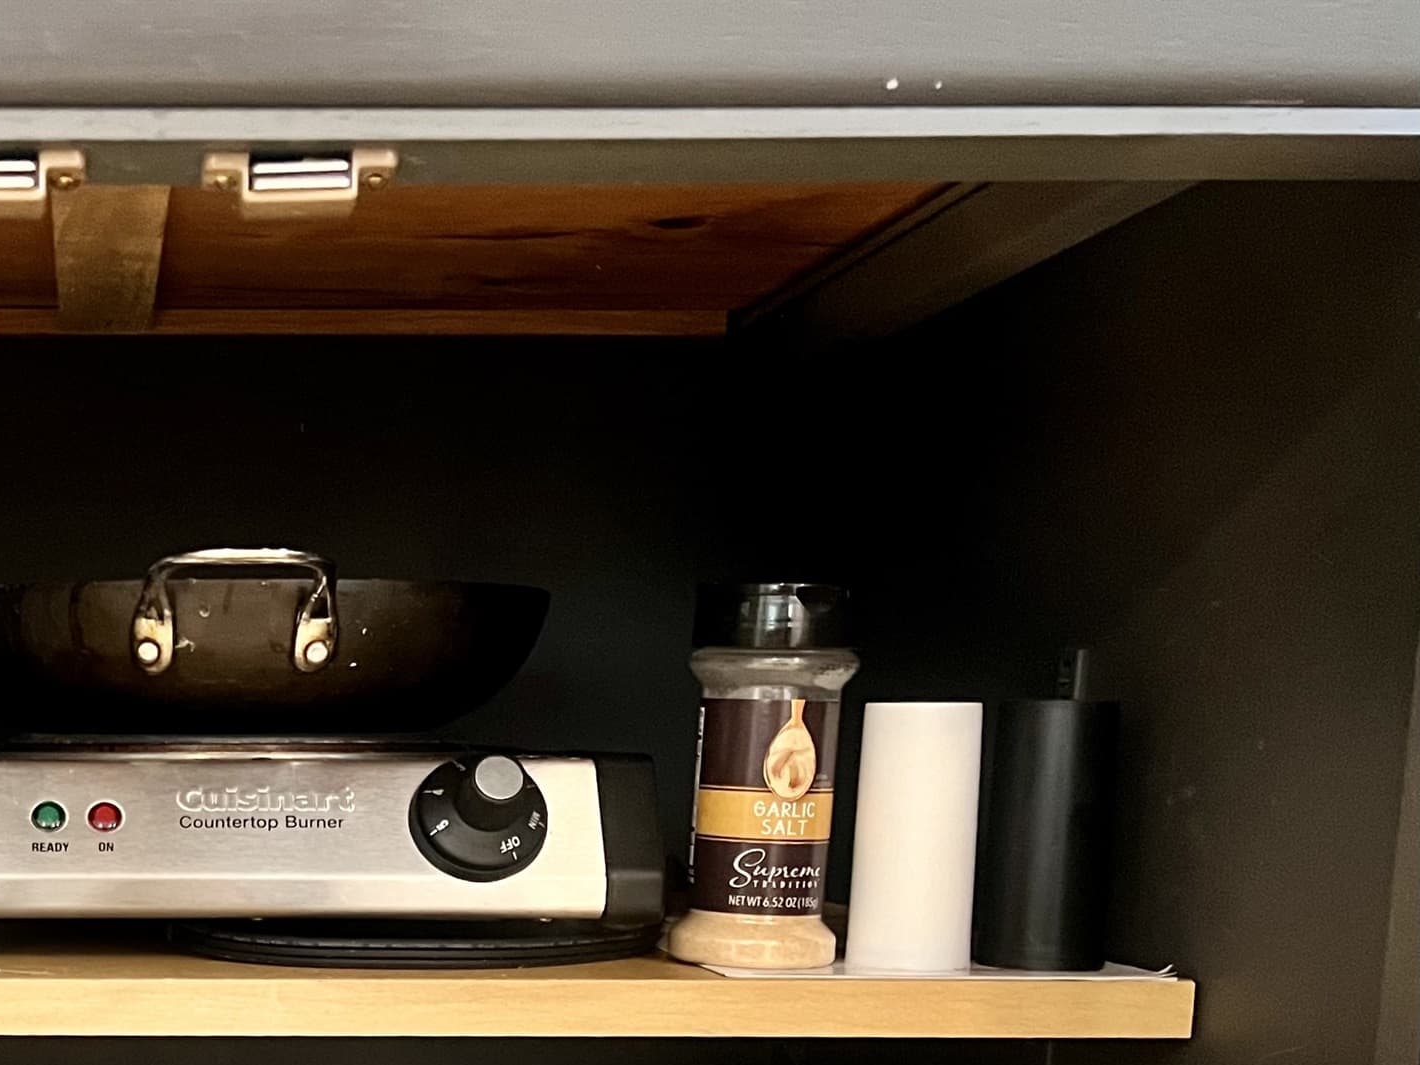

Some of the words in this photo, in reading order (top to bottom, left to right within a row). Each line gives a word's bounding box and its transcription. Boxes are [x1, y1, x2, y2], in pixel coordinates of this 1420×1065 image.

[176, 786, 355, 812] Cuisinart
[753, 801, 815, 818] GARLIC
[179, 815, 279, 831] Countertop
[285, 815, 345, 829] Burner
[760, 820, 808, 836] SALT
[31, 841, 69, 852] READY
[98, 842, 114, 852] ON
[500, 836, 521, 854] OFF
[729, 848, 820, 888] Supreme
[728, 894, 746, 906] NET
[746, 896, 762, 908] WT
[762, 897, 784, 908] 6.52
[785, 897, 797, 909] OZ
